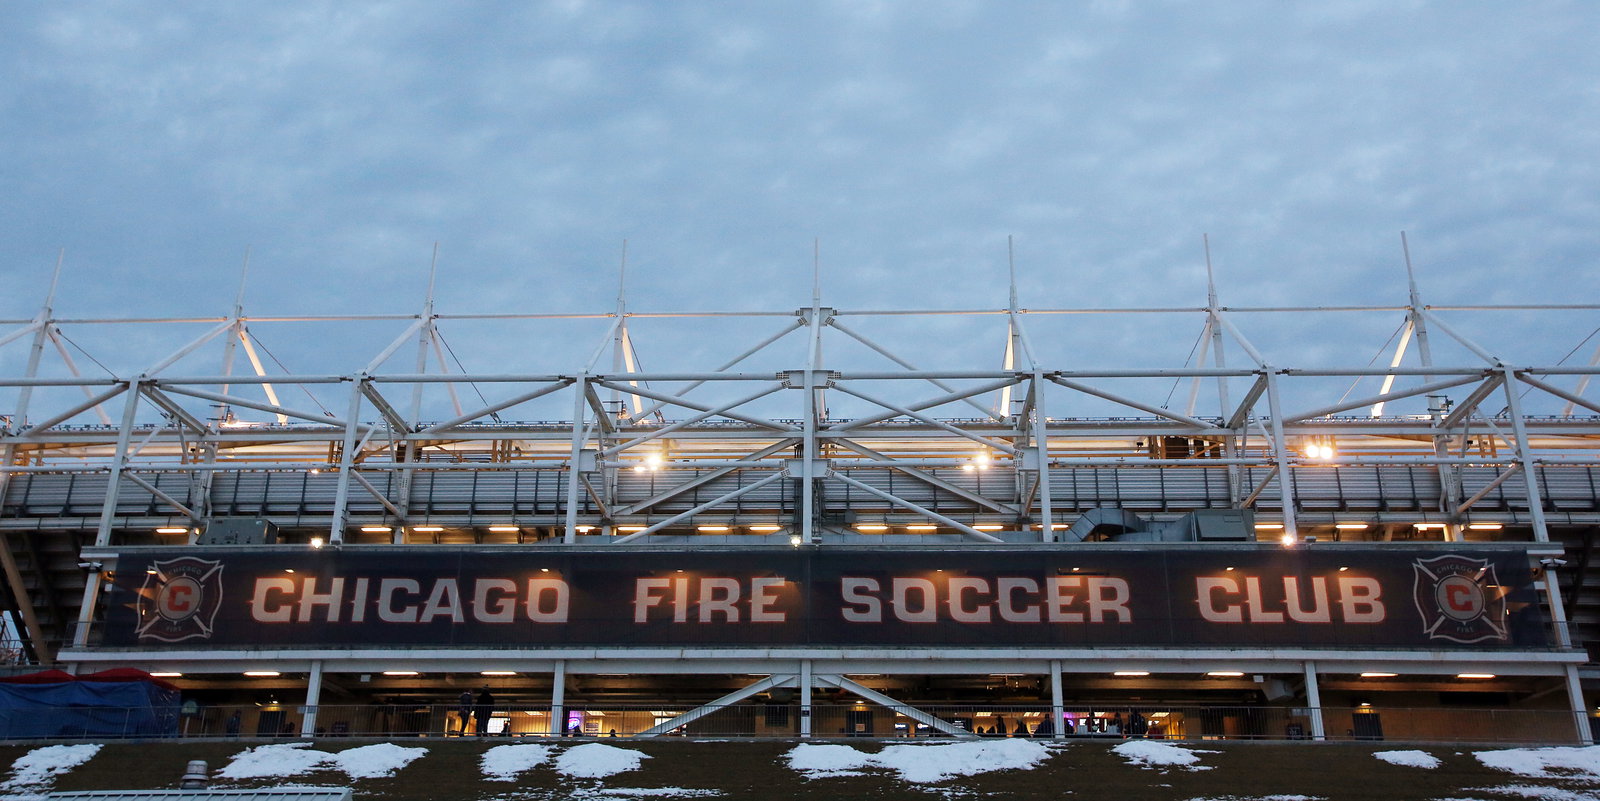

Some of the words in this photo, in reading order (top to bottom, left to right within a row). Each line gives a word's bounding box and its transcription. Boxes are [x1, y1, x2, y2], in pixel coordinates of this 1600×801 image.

[1436, 564, 1473, 574] CHICAGO
[167, 586, 192, 612] C
[250, 577, 570, 623] CHICAGO
[633, 577, 786, 623] FIRE
[841, 577, 1132, 623] SOCCER
[1195, 576, 1386, 623] CLUB
[1445, 584, 1475, 612] C
